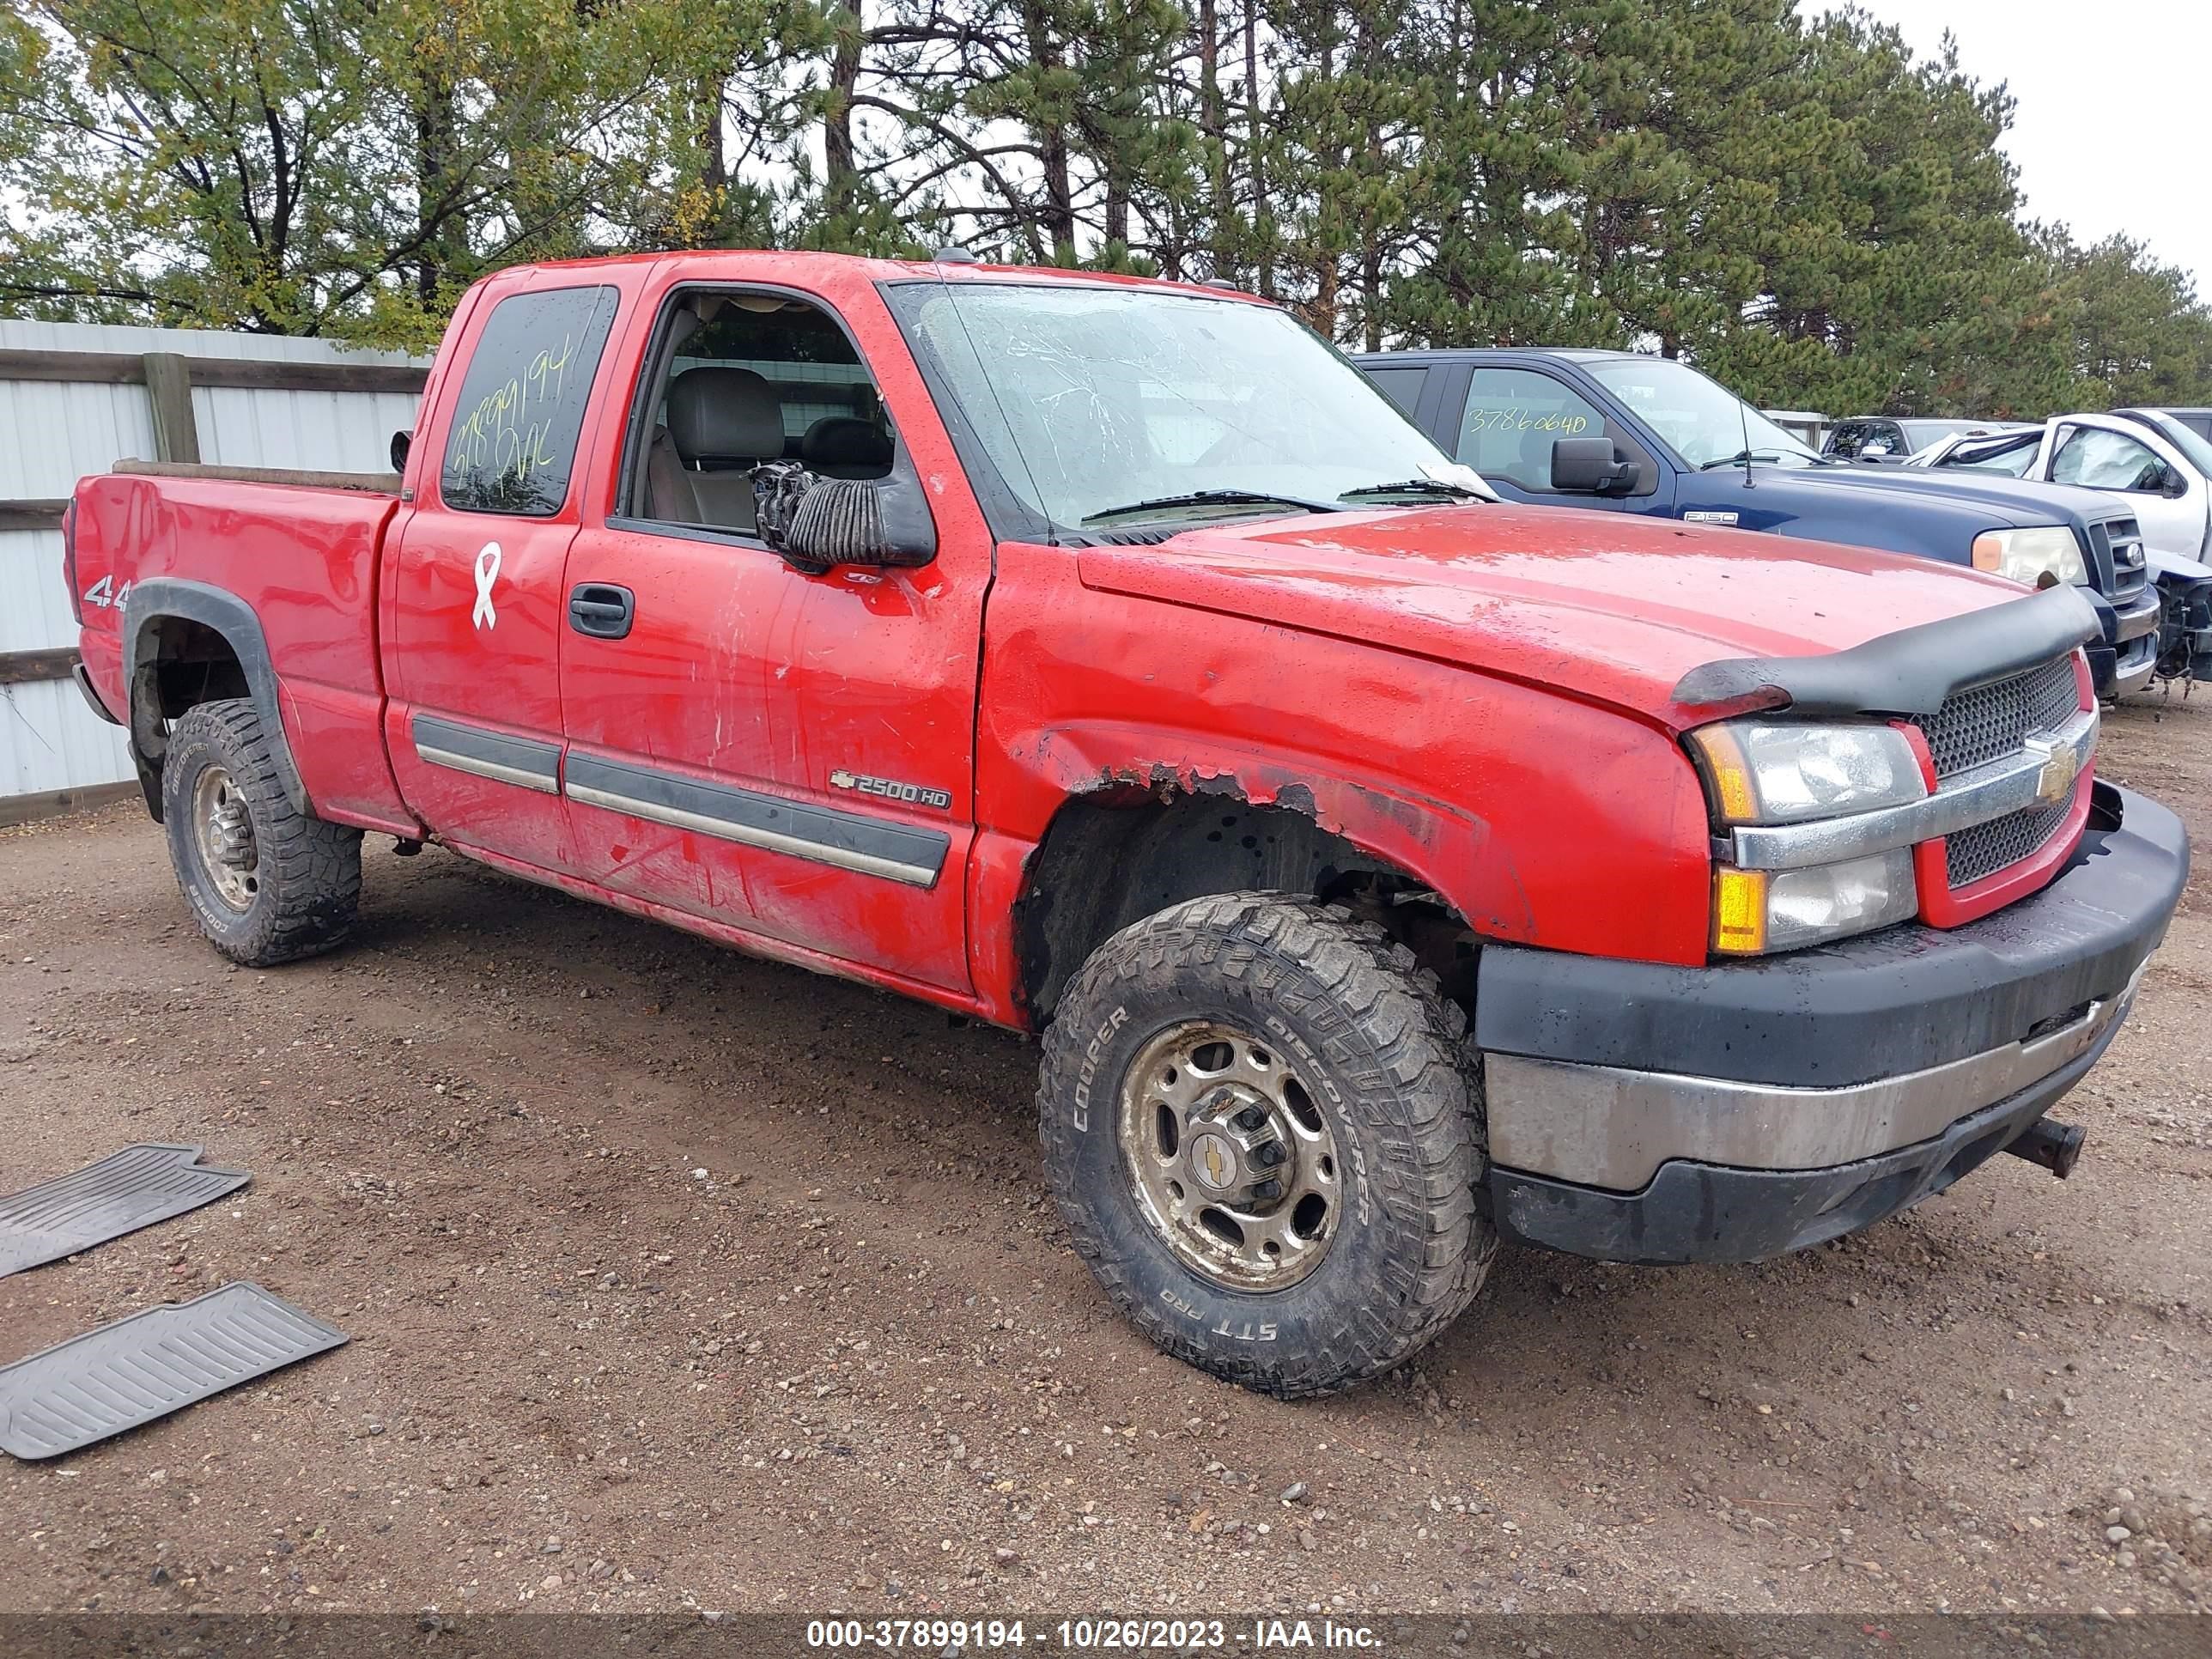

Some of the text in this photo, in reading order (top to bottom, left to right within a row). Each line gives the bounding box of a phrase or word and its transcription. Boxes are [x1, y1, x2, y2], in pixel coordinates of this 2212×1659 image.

[1469, 406, 1587, 435] 37860640
[858, 775, 948, 807] 2500 HD
[1073, 1005, 1132, 1133] COOPER
[1265, 1015, 1370, 1228] DISCOVERER
[1159, 1288, 1278, 1342] STT PRO
